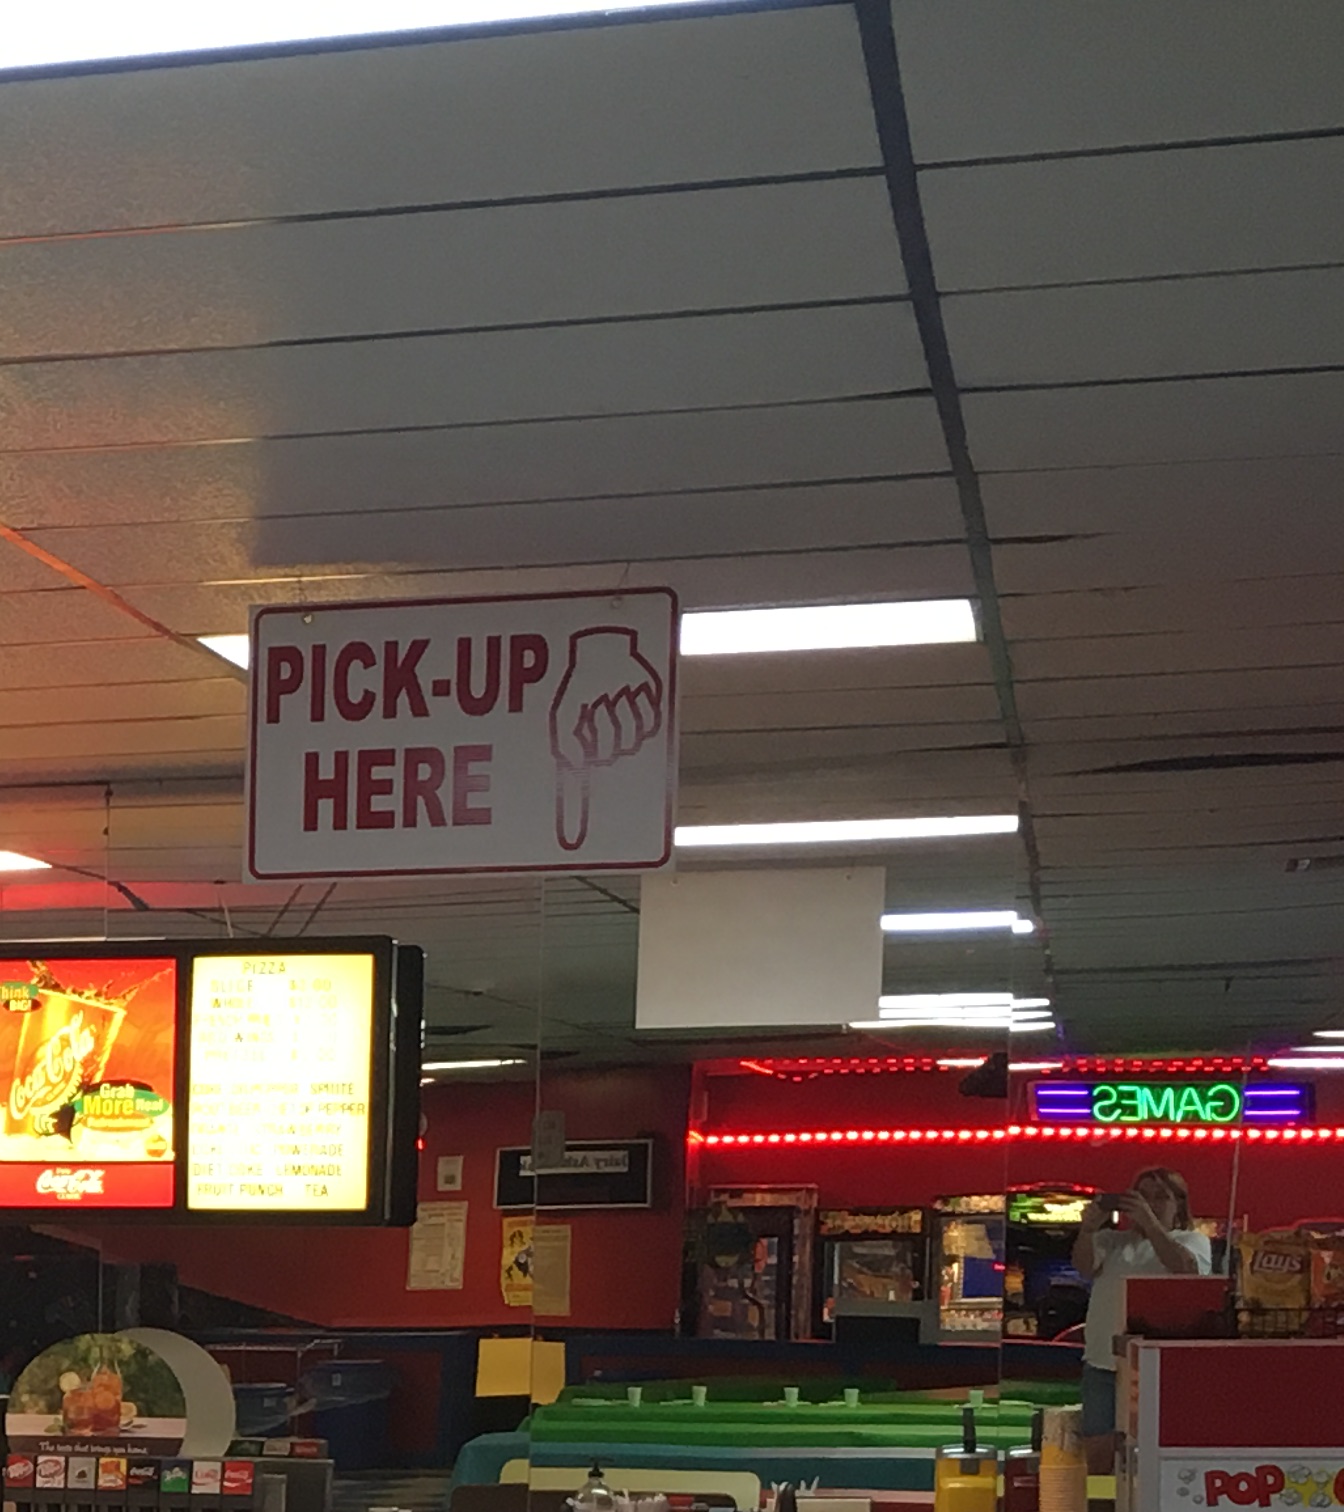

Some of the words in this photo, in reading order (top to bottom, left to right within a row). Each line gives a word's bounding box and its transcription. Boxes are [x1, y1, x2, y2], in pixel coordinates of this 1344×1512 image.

[266, 633, 550, 725] PICK-UP
[303, 743, 493, 832] HERE
[243, 962, 286, 975] PIZZA
[100, 1083, 135, 1098] Grab
[83, 1096, 134, 1115] More
[305, 1183, 329, 1197] TEA
